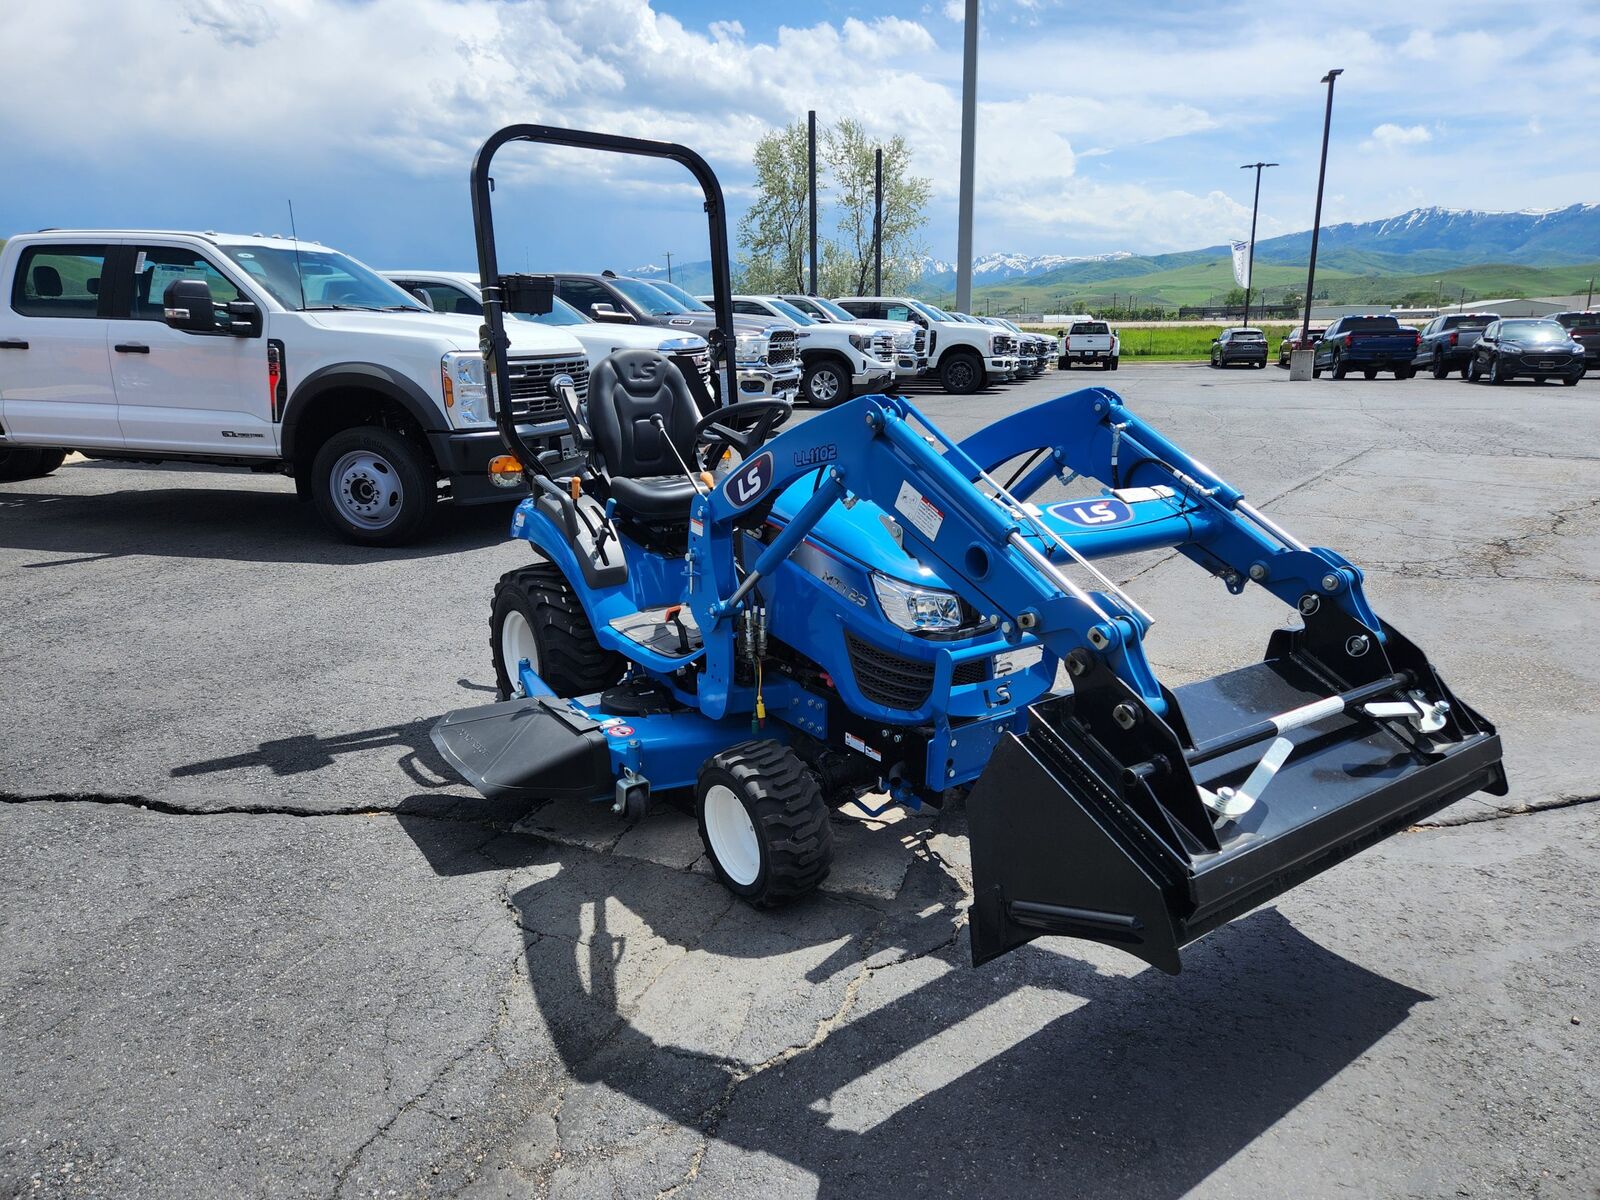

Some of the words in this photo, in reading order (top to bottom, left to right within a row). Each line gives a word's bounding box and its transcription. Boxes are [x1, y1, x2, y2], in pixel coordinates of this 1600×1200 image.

[628, 360, 657, 382] LS
[793, 444, 837, 467] LL1102
[737, 466, 762, 502] LS
[1073, 503, 1117, 524] LS
